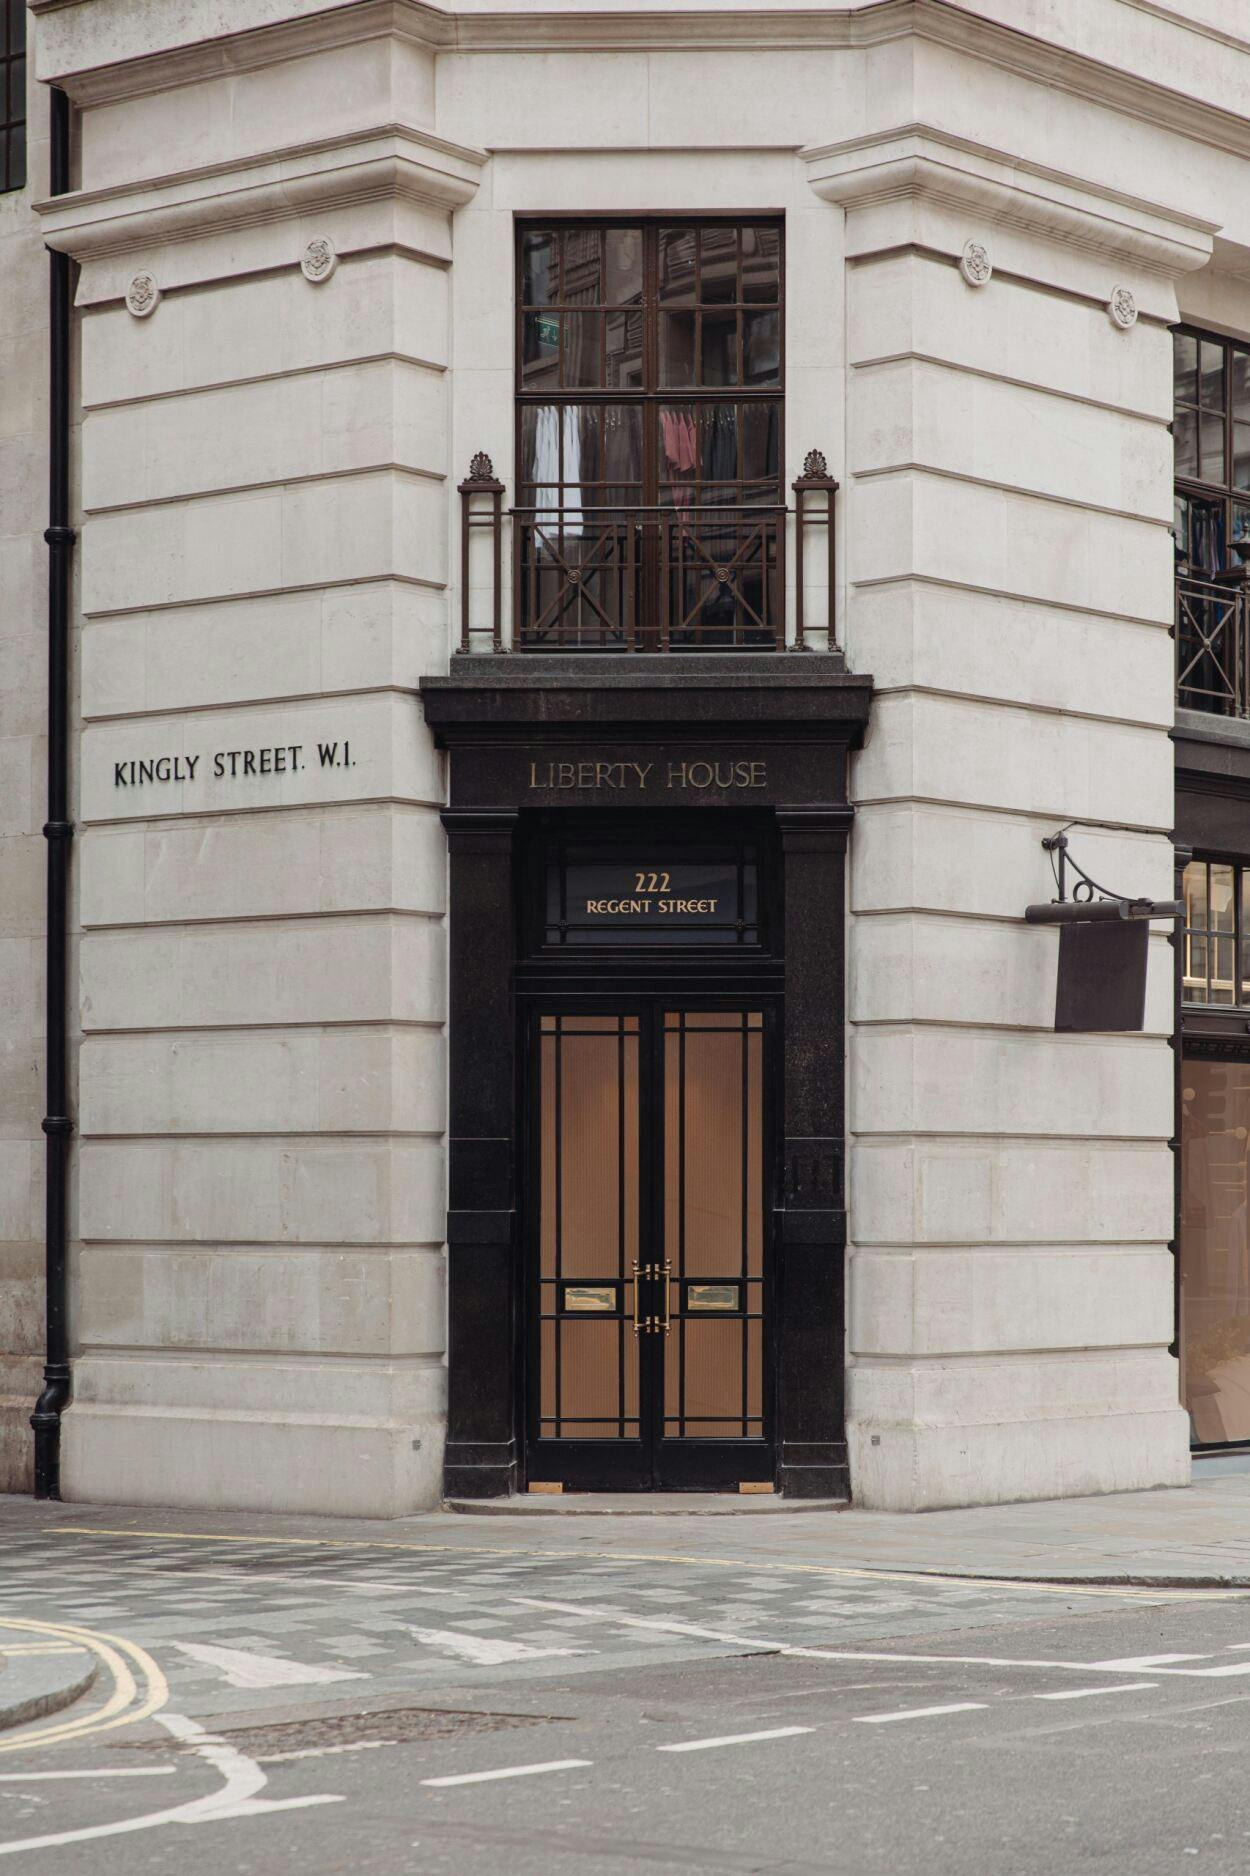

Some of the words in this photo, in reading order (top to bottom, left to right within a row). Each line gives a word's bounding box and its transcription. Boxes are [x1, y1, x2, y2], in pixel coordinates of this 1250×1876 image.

[114, 756, 200, 787] KINGLY
[213, 745, 305, 777] STREET.
[529, 763, 655, 788] LIBERTY
[667, 762, 767, 788] HOUSE
[635, 873, 671, 892] 222
[586, 900, 652, 914] REGENT
[658, 900, 717, 913] STREET
